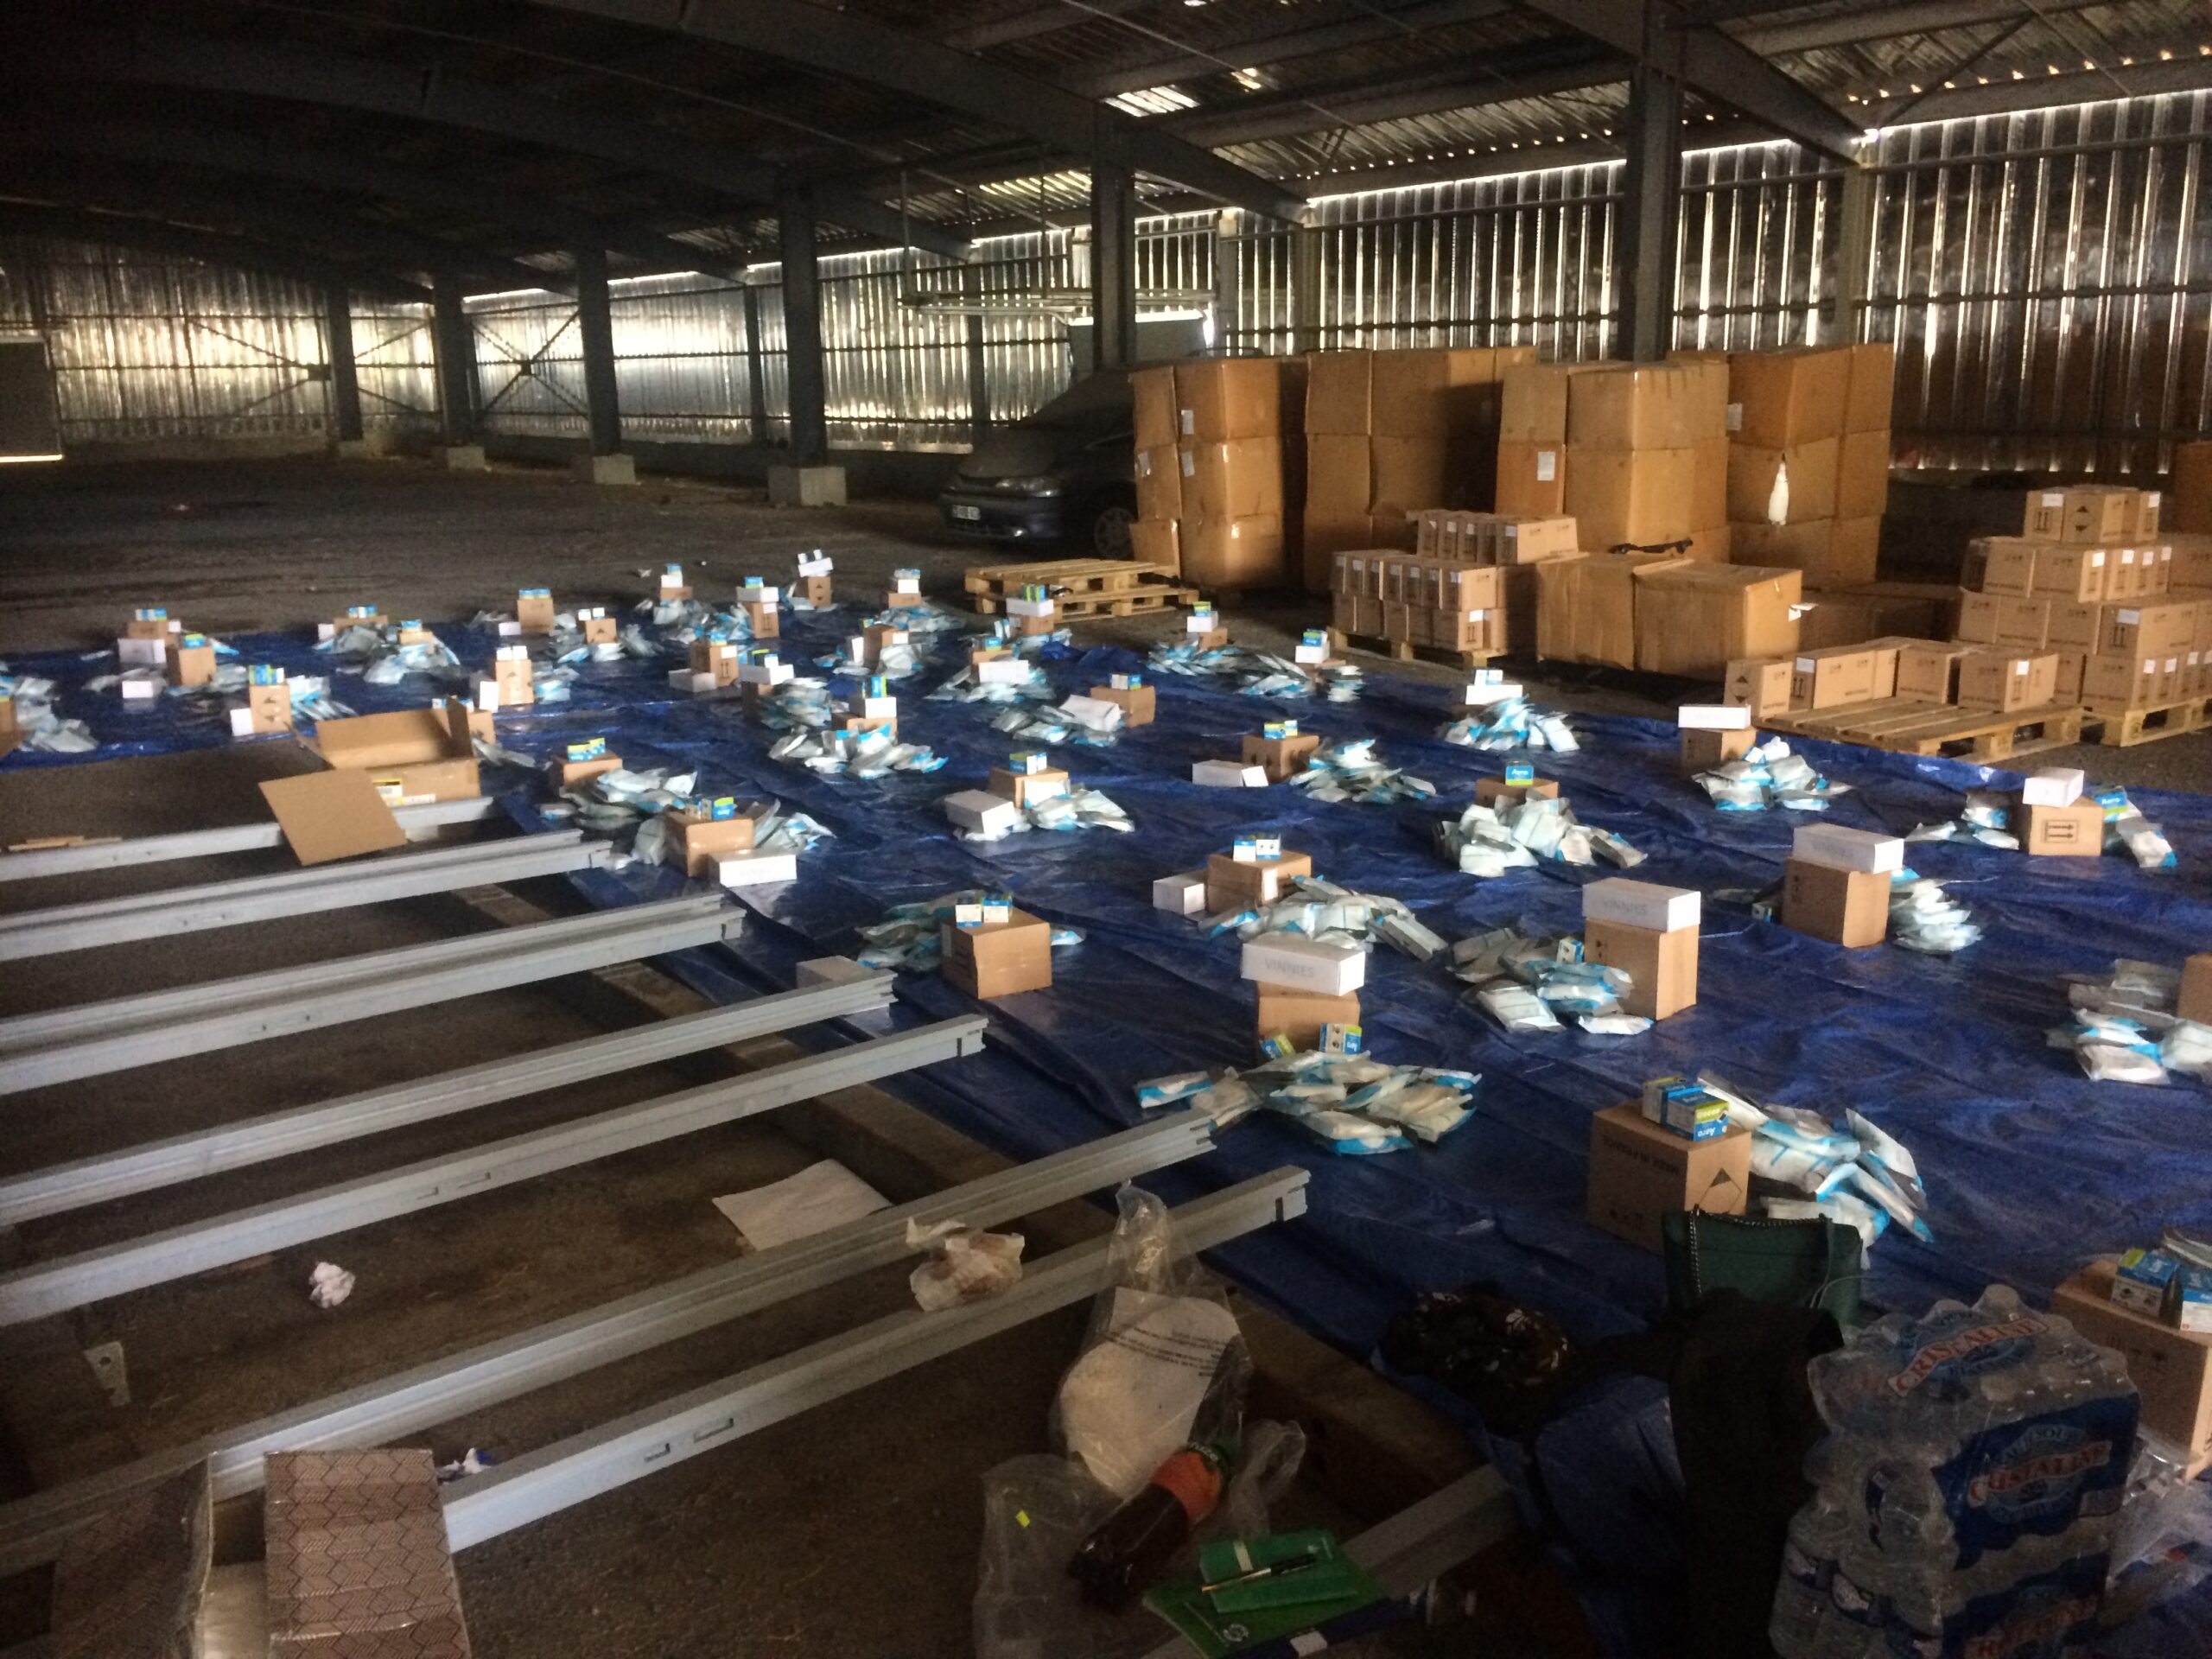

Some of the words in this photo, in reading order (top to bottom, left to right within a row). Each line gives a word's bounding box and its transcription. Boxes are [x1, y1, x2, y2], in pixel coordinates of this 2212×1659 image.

[1602, 898, 1649, 915] VINNIES
[1264, 958, 1315, 978] VINNIES
[1895, 1319, 2045, 1392] CRISTALINE
